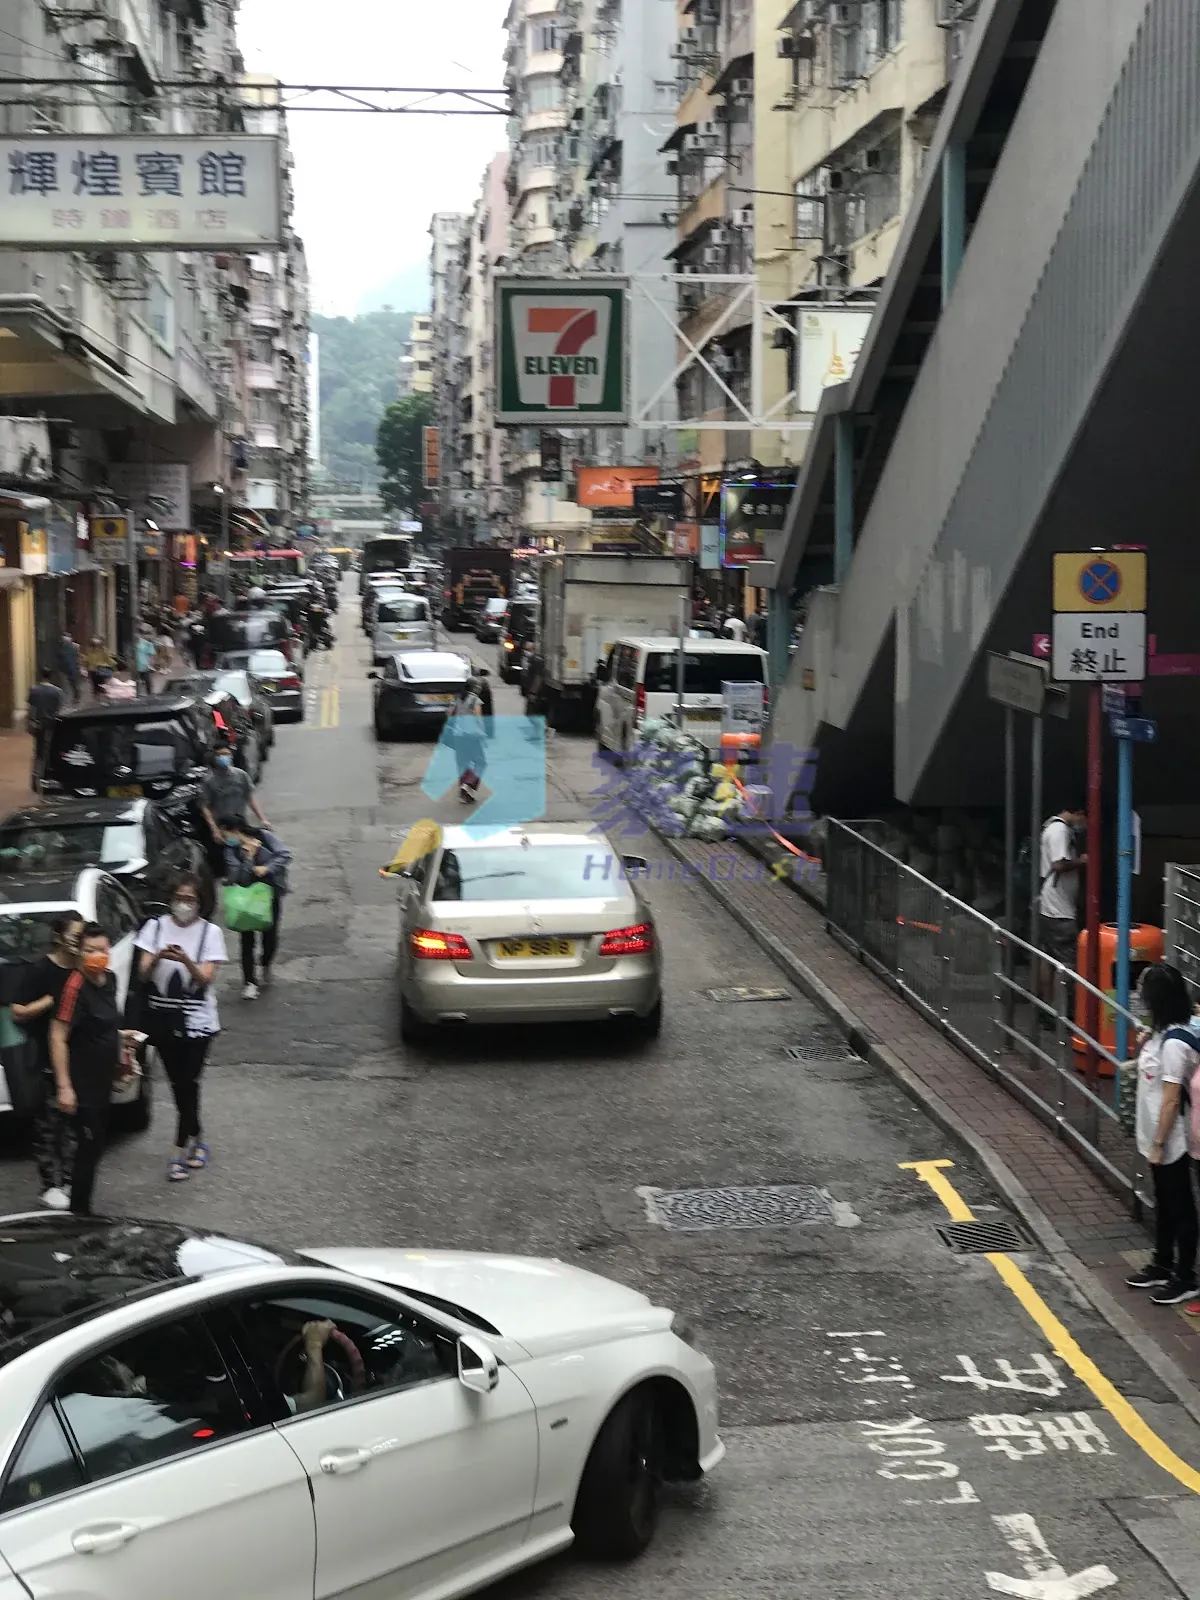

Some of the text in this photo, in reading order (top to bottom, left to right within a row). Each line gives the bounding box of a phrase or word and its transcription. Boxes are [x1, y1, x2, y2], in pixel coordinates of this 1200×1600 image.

[7, 150, 247, 197] 輝煌賓館
[528, 308, 598, 407] 7
[1081, 622, 1119, 638] End
[1070, 648, 1127, 674] 終止
[857, 1412, 981, 1505] LOOK
